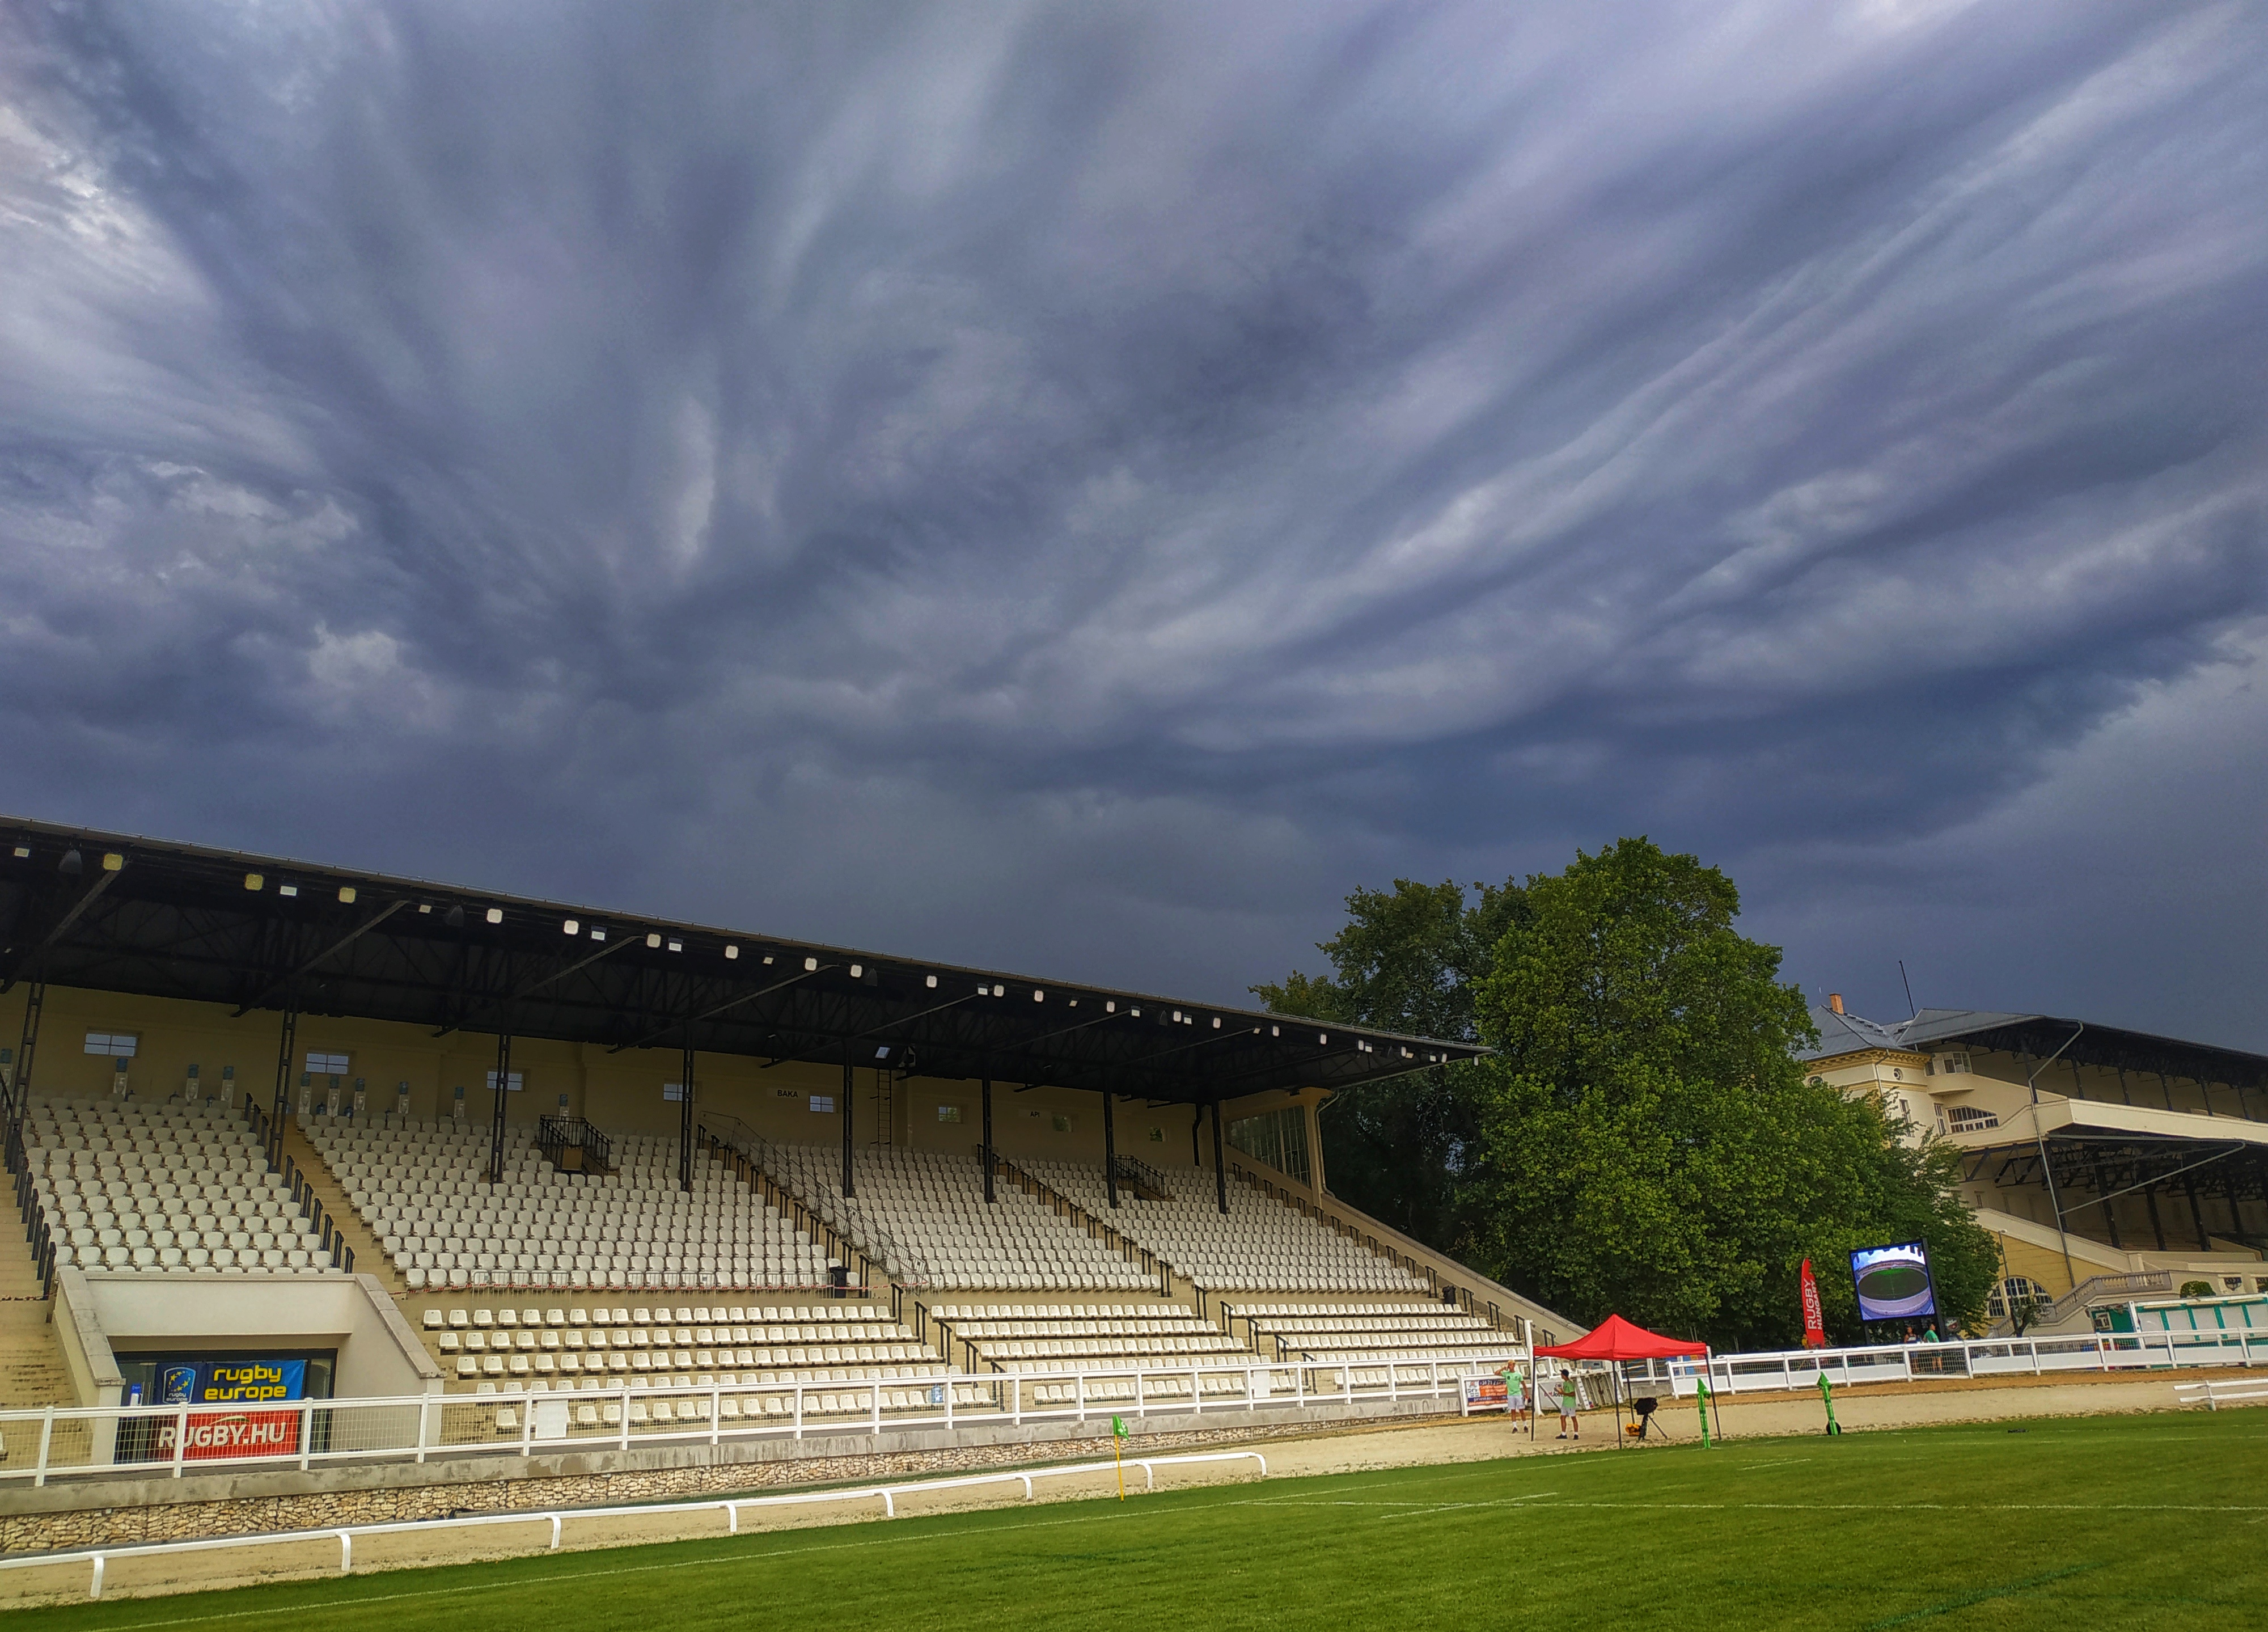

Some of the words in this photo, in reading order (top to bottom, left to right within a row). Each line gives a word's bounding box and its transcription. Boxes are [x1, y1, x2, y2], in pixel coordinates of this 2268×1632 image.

[777, 1089, 798, 1098] BAKA
[1803, 1277, 1817, 1330] RUGBY
[1810, 1279, 1823, 1330] HUNGARY
[213, 1364, 282, 1384] rugby
[204, 1385, 287, 1402] europe
[158, 1422, 286, 1447] RUGBY.HU
